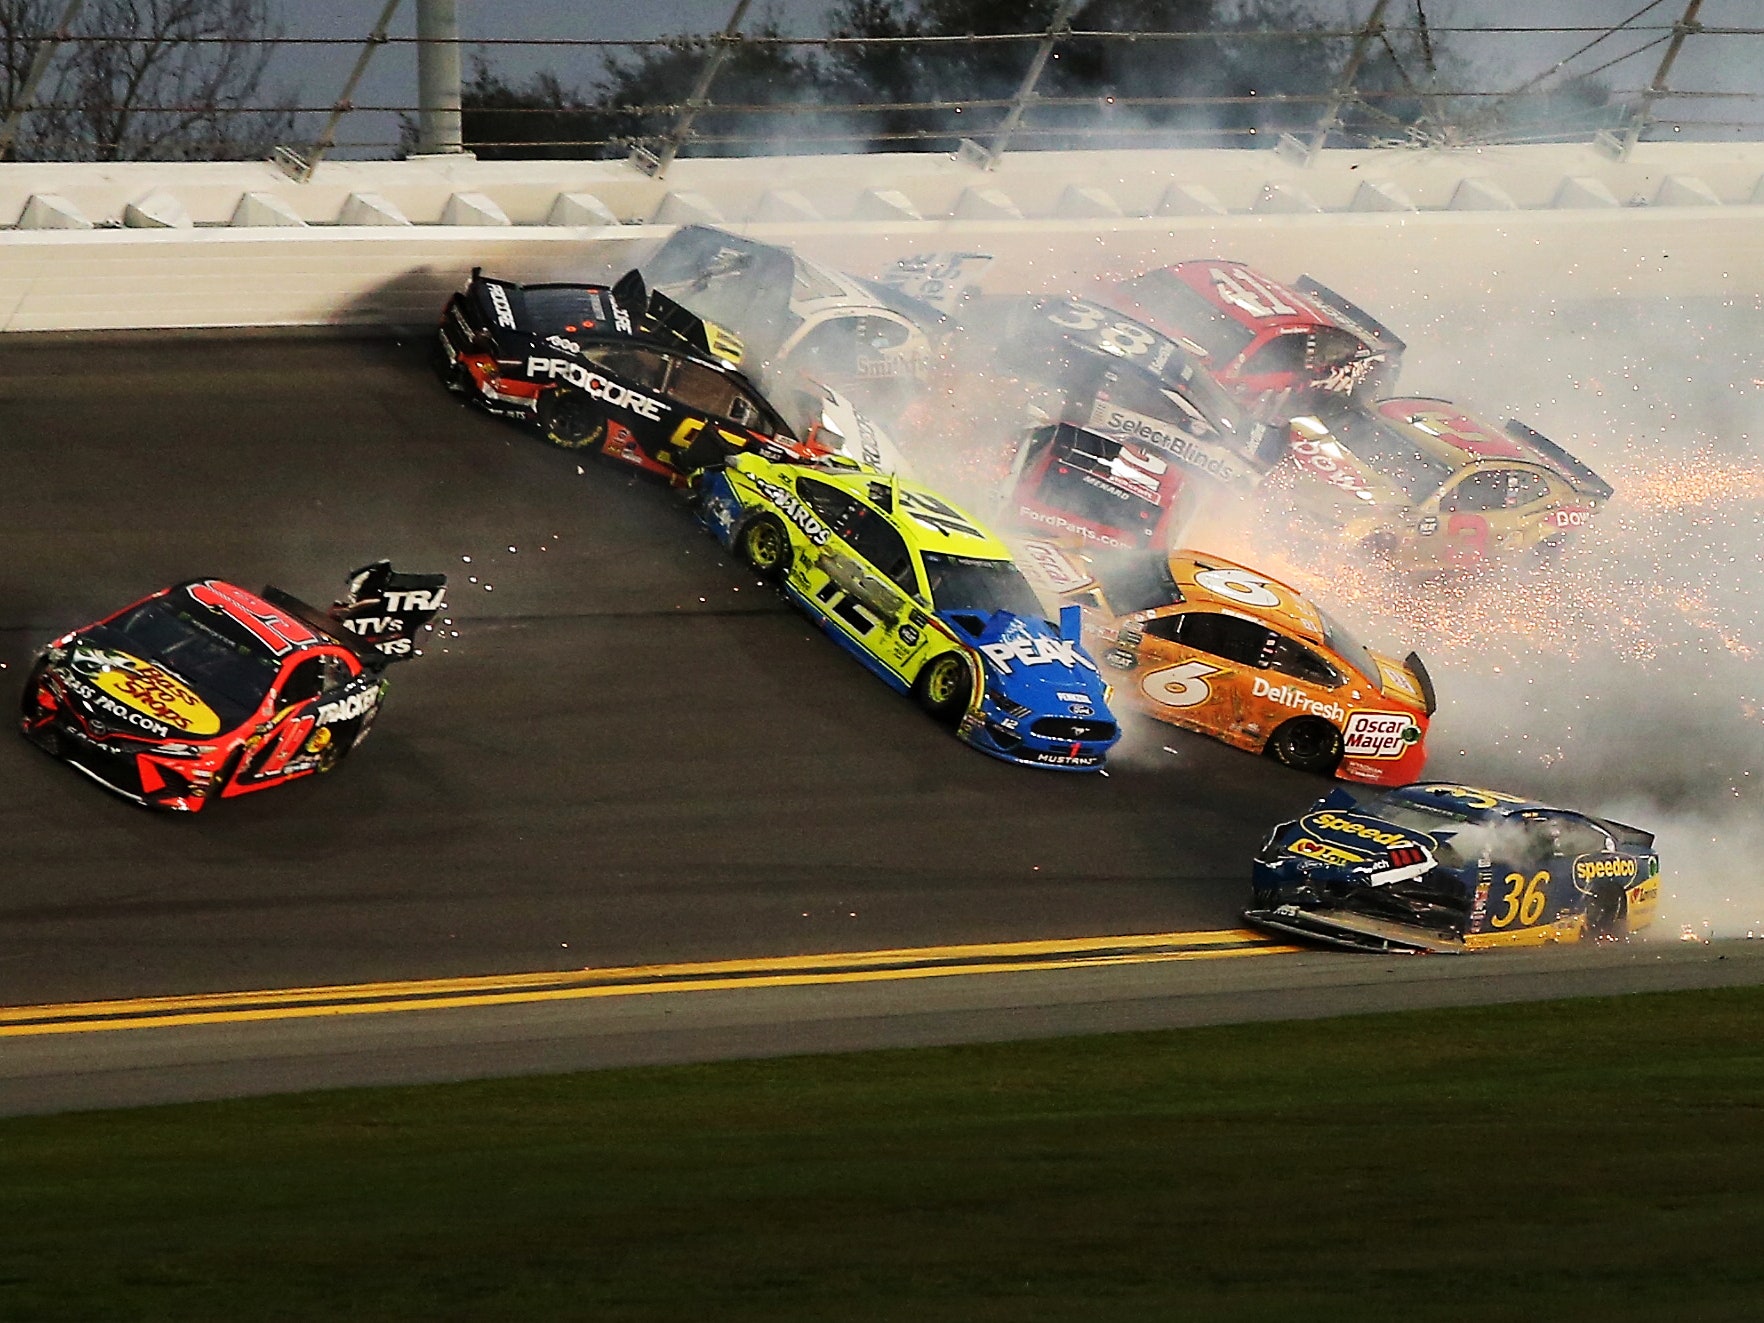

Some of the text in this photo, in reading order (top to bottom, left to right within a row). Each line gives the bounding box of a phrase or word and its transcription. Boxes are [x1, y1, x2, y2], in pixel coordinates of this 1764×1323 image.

[1208, 267, 1297, 318] 41
[1048, 300, 1156, 356] 38
[526, 355, 673, 423] PROCORE
[1107, 411, 1234, 481] SelectBlinds
[1083, 475, 1130, 501] MENARD
[1019, 506, 1136, 551] FordParts.com
[1194, 566, 1281, 608] 6
[979, 634, 1098, 676] PEAK
[113, 680, 193, 730] Shops
[139, 665, 199, 706] Bass
[1141, 660, 1220, 709] 6
[1251, 677, 1345, 723] DeliFresh
[95, 694, 169, 738] PRO.COM
[1000, 718, 1019, 730] 12
[1355, 718, 1405, 734] Oscar
[1345, 733, 1403, 758] Mayer
[1576, 856, 1635, 881] speedco
[1490, 869, 1552, 929] 36
